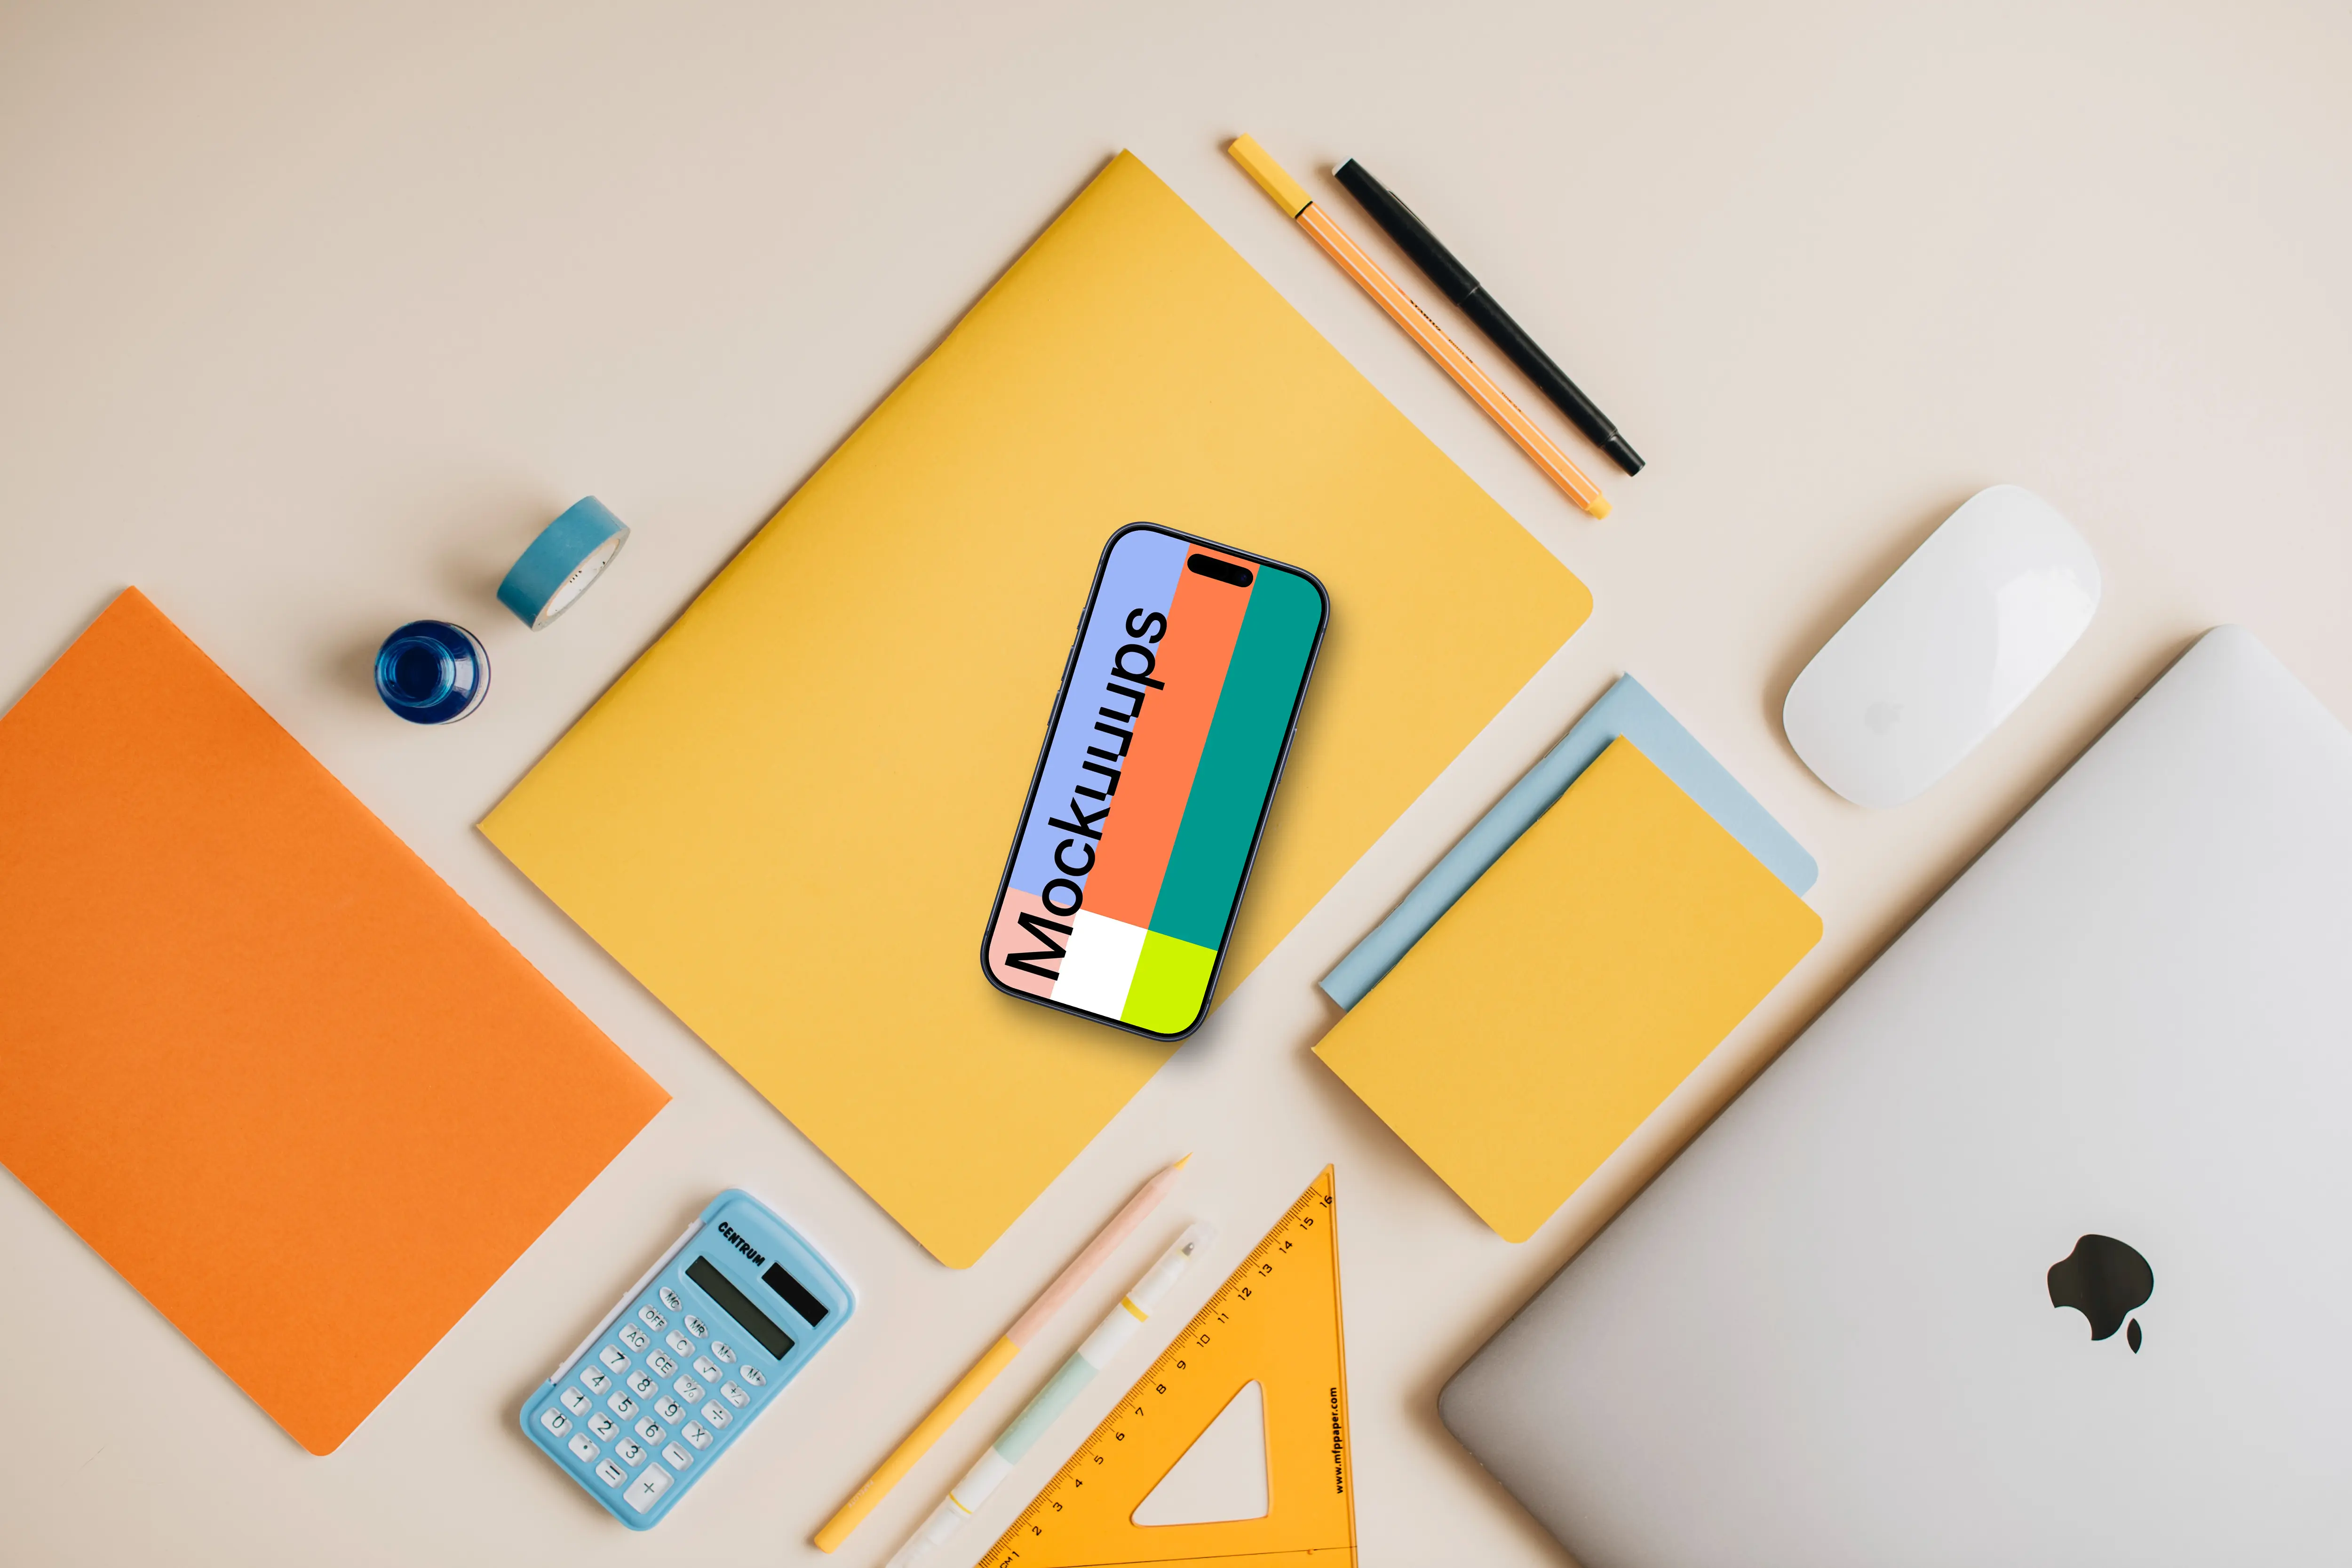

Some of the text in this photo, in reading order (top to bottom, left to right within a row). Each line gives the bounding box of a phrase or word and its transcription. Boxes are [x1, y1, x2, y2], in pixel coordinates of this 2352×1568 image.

[1005, 608, 1167, 981] Mockuuups
[718, 1222, 765, 1266] CENTRUM
[665, 1293, 679, 1308] MC
[646, 1311, 664, 1327] OFF
[690, 1320, 705, 1336] MR
[627, 1332, 644, 1347] AC
[677, 1340, 687, 1350] C
[611, 1352, 625, 1363] 7
[718, 1346, 730, 1358] M-
[655, 1357, 672, 1374] CE
[592, 1376, 605, 1387] 4
[747, 1369, 761, 1381] M+
[1000, 1556, 1013, 1568] CM
[1032, 1526, 1042, 1536] 2
[1053, 1502, 1063, 1512] 3
[1075, 1479, 1083, 1488] 4
[1094, 1455, 1104, 1465] 5
[1115, 1432, 1125, 1441] 6
[1135, 1407, 1144, 1417] 7
[1156, 1384, 1167, 1394] 8
[1176, 1360, 1186, 1370] 9
[1196, 1334, 1210, 1347] 10
[1217, 1313, 1229, 1323] 11
[1238, 1287, 1252, 1300] 12
[1258, 1263, 1272, 1277] 13
[1279, 1241, 1293, 1254] 14
[1300, 1217, 1314, 1230] 15
[1319, 1195, 1333, 1208] 16
[637, 1379, 650, 1391] 8
[684, 1383, 696, 1397] %
[573, 1396, 584, 1407] 1
[619, 1398, 632, 1412] 5
[665, 1404, 677, 1417] 9
[552, 1416, 565, 1428] 0
[597, 1421, 612, 1435] 2
[646, 1425, 658, 1437] 6
[1330, 1387, 1343, 1494] www.mfppaper.com
[626, 1445, 638, 1458] 3
